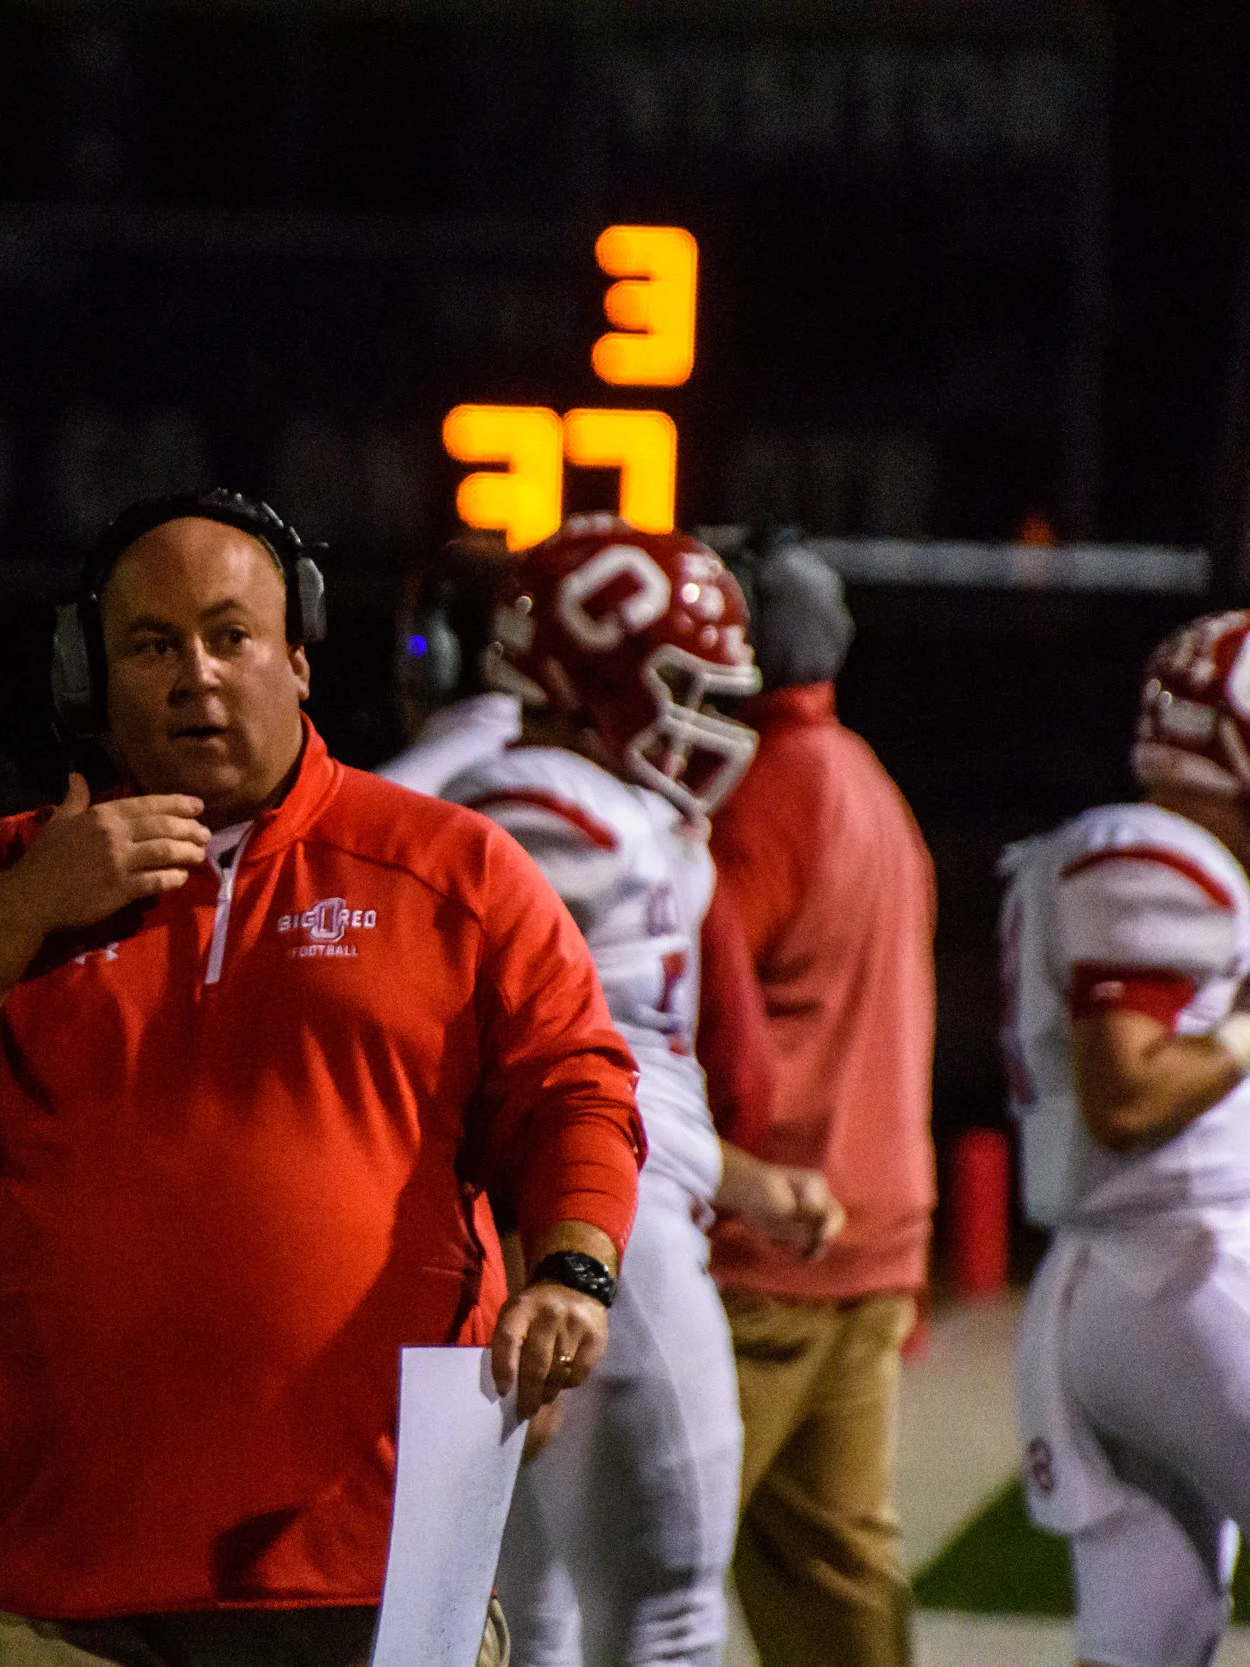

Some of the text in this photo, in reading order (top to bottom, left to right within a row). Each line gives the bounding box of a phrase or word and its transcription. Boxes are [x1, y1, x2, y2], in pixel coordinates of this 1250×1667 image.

[592, 224, 698, 387] 3
[277, 911, 314, 932] BIG
[338, 908, 377, 928] RED
[291, 944, 358, 957] FOOTBALL
